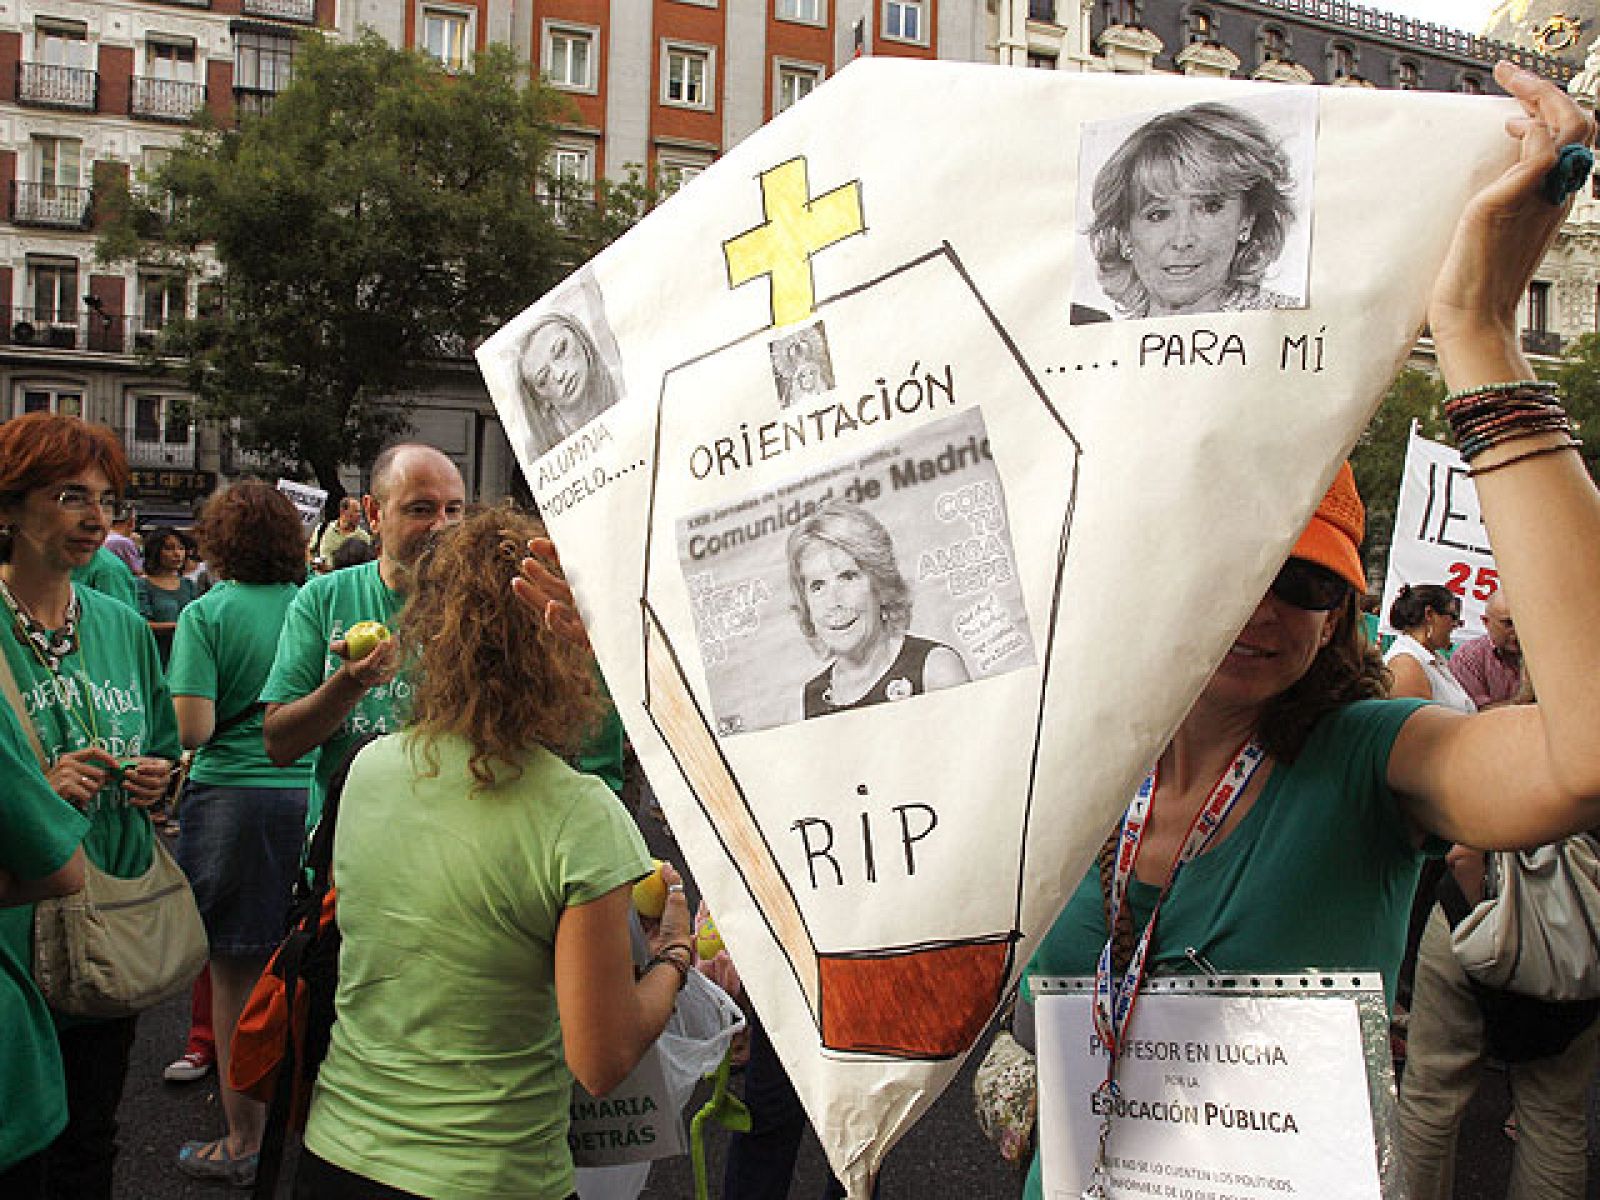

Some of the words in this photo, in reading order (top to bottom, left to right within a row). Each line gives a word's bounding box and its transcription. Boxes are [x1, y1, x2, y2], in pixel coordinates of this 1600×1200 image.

[1140, 329, 1246, 366] PARA
[1280, 325, 1327, 373] MÍ
[844, 477, 881, 503] de
[1089, 1034, 1181, 1063] PFESOR
[1186, 1041, 1210, 1064] EN
[1216, 1043, 1289, 1067] LUCHA
[1204, 1101, 1299, 1134] PÚBLICA
